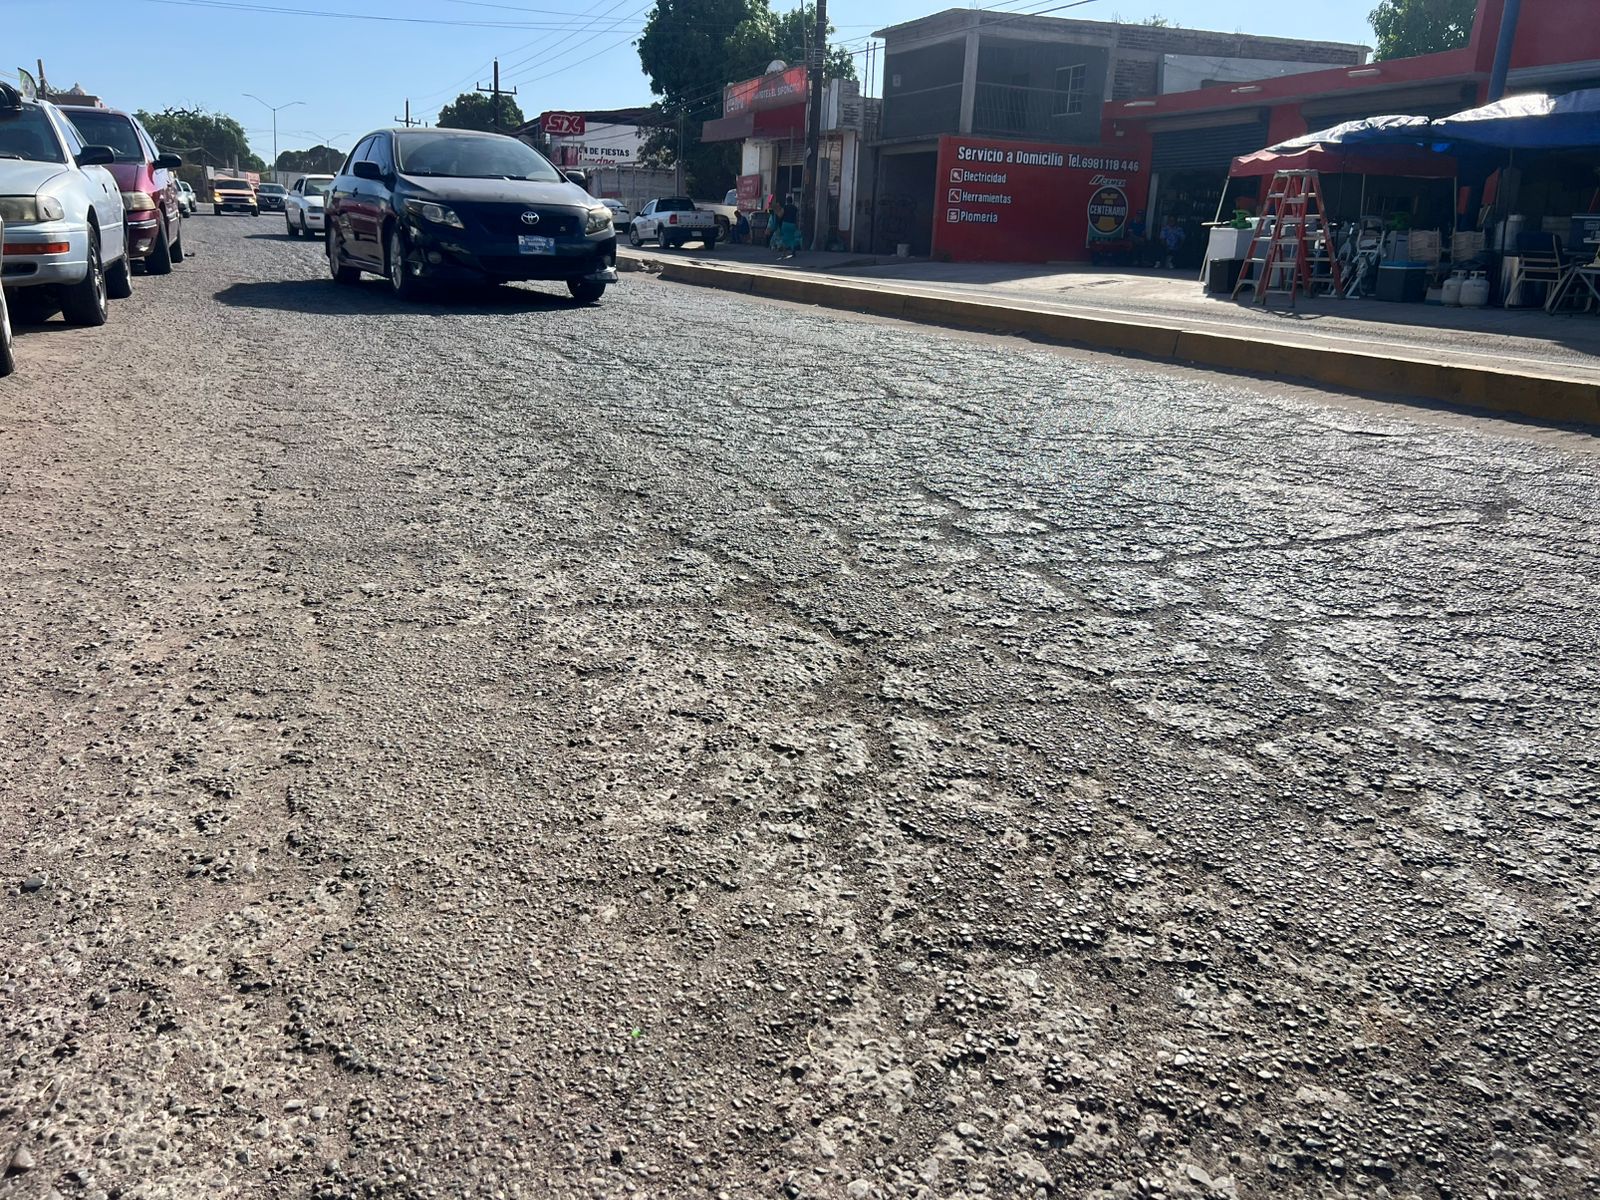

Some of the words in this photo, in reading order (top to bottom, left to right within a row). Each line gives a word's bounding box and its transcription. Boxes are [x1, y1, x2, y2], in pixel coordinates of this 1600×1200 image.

[545, 114, 580, 134] SIX
[590, 147, 599, 155] DE
[601, 148, 630, 157] FIESTAS
[958, 146, 1003, 162] Servicio
[1006, 151, 1013, 162] a
[1016, 150, 1063, 166] Domicilio
[964, 171, 1007, 183] Electricidad
[962, 191, 1011, 204] Herramientas
[1090, 204, 1126, 217] CENTENARIO
